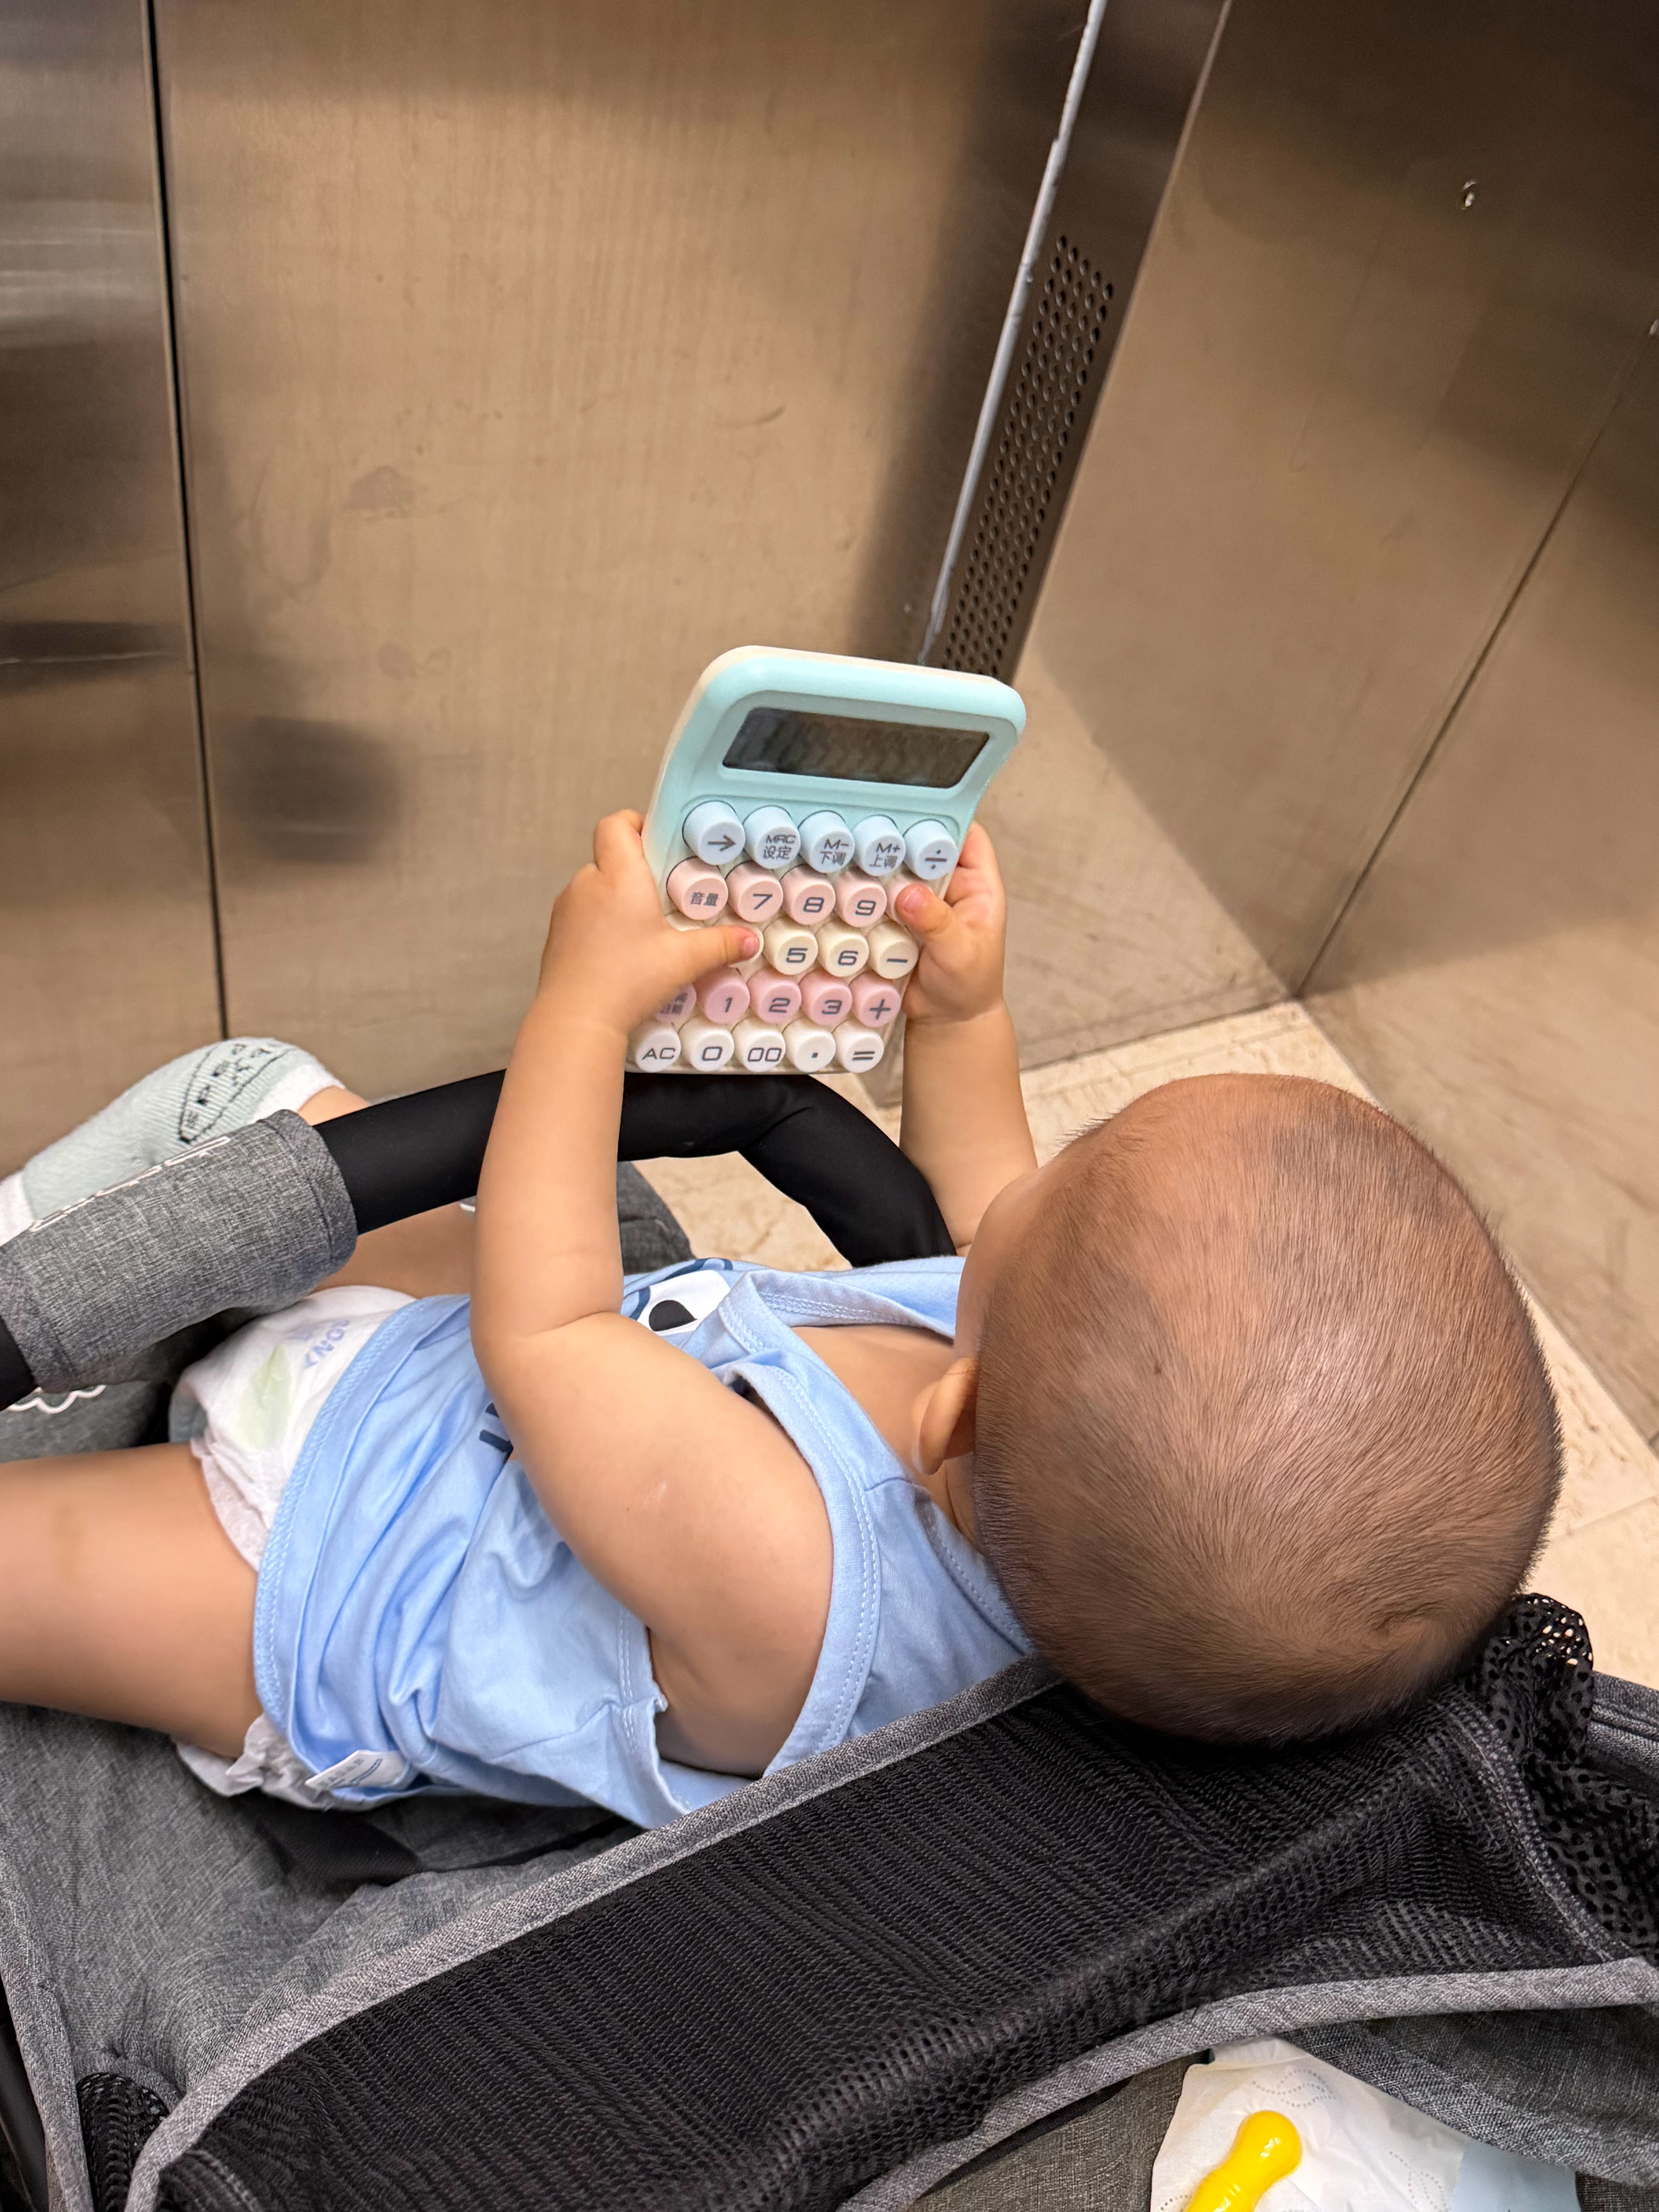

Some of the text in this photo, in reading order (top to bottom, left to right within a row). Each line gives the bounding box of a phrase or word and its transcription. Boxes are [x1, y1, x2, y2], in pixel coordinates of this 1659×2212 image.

[765, 834, 796, 844] MRC
[763, 845, 792, 859] 设定
[876, 842, 900, 853] M+
[820, 851, 847, 866] 下调
[869, 854, 898, 868] 上调
[690, 892, 718, 906] 音量
[752, 893, 773, 910] 7
[803, 897, 824, 913] 8
[855, 900, 876, 916] 9
[786, 948, 807, 963] 5
[838, 950, 859, 966] 6
[725, 997, 733, 1013] 1
[768, 998, 790, 1013] 2
[822, 1000, 842, 1015] 3
[642, 1048, 675, 1060] AC
[702, 1046, 723, 1061] 0
[748, 1047, 782, 1062] 00
